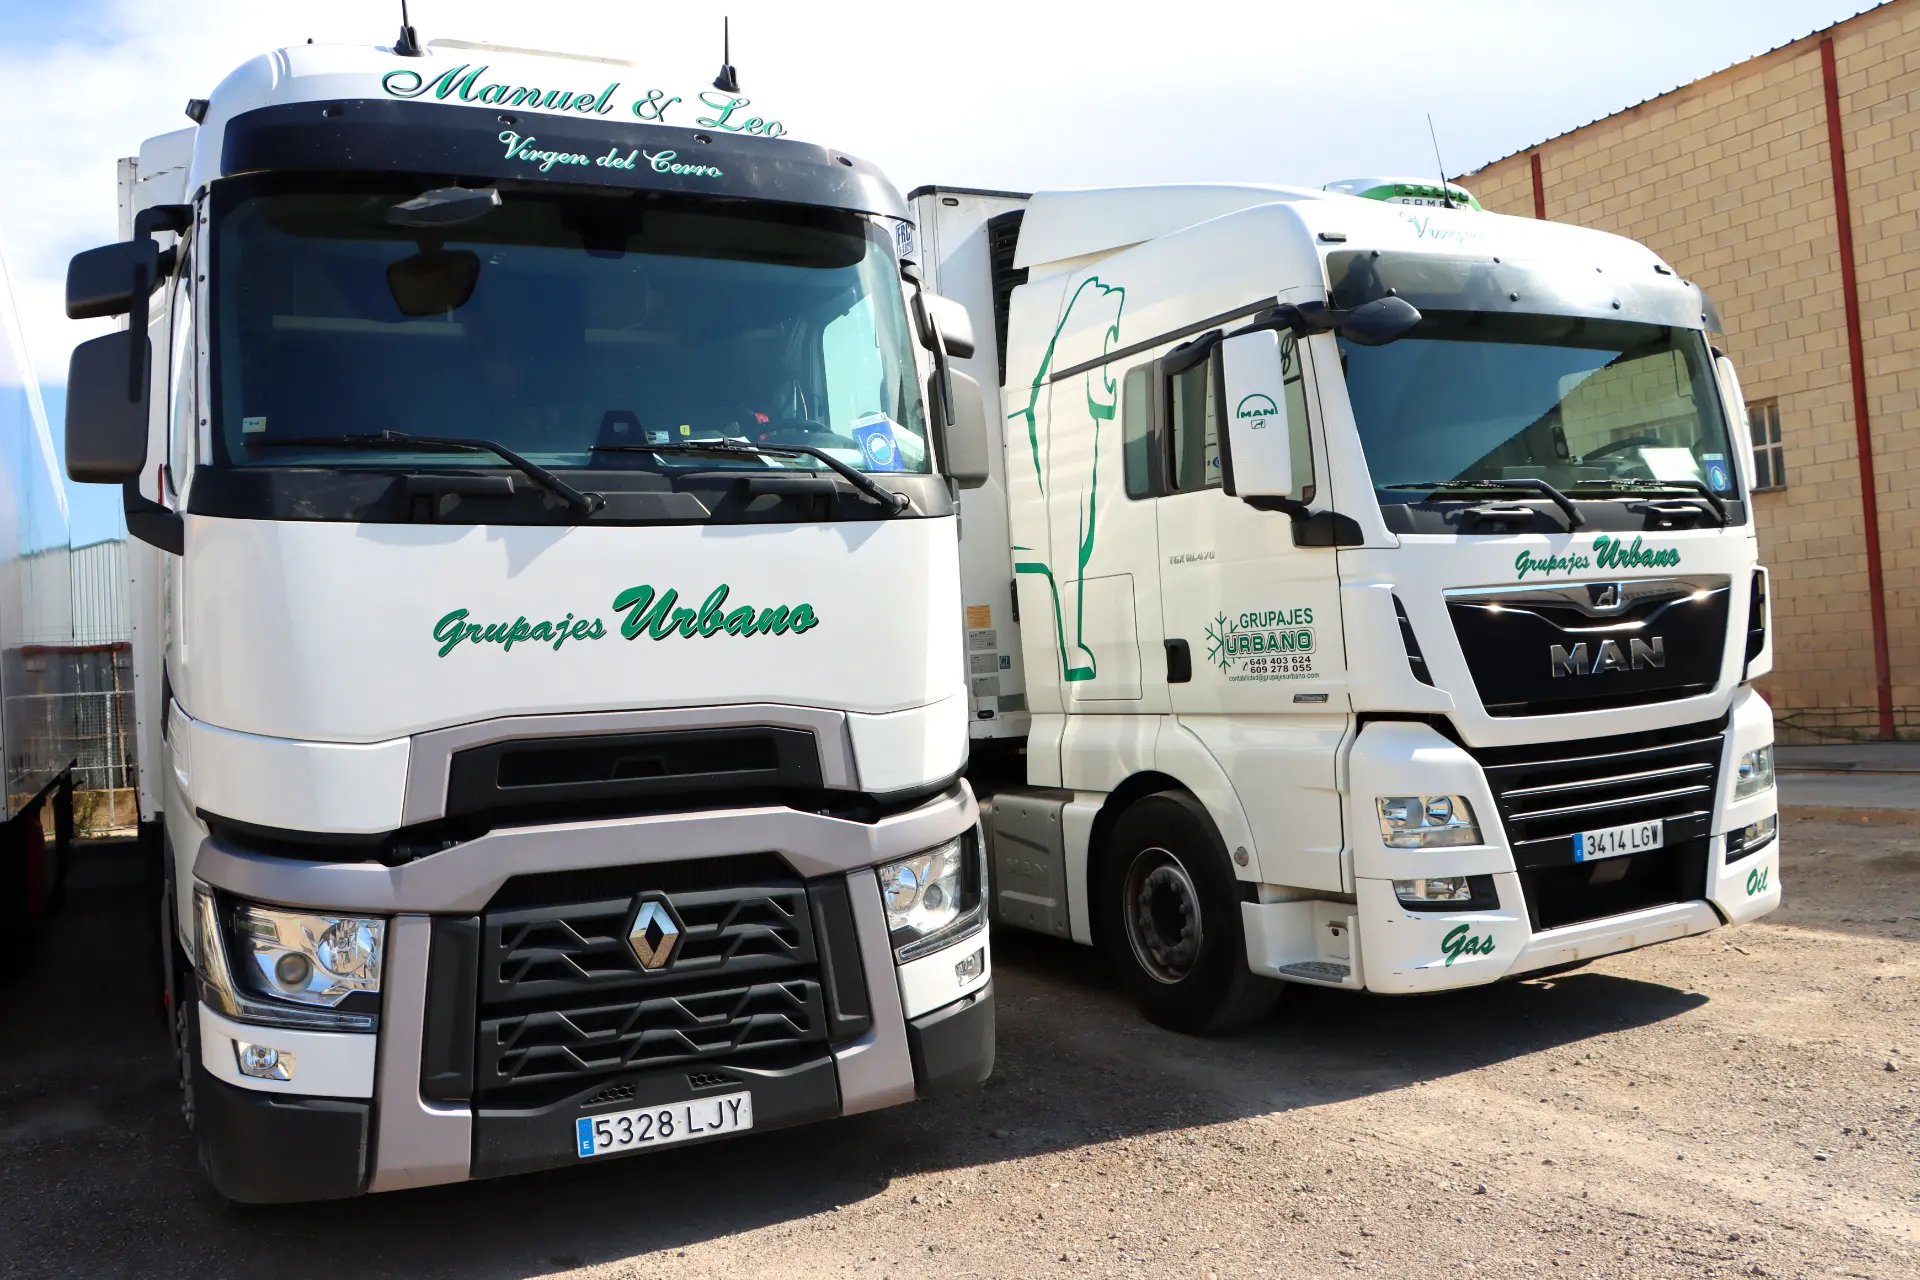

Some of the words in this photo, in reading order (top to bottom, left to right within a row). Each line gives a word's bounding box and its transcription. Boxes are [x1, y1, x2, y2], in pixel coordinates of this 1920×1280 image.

[381, 62, 622, 116] Manuel
[631, 88, 683, 122] &
[695, 90, 788, 138] Leo
[498, 129, 590, 173] Virgen
[596, 147, 637, 170] del
[642, 149, 724, 179] Cerro
[1401, 197, 1469, 211] COMPCT
[1240, 408, 1275, 419] MAN
[1514, 549, 1590, 580] Grupajes
[1592, 534, 1681, 570] Urbano
[432, 608, 608, 658] Grupajes
[612, 583, 820, 641] Urbano
[1239, 607, 1314, 629] GRUPAJES
[1225, 629, 1314, 656] URBANO
[1550, 636, 1666, 678] MAN
[1249, 657, 1268, 666] 649
[1270, 656, 1289, 665] 403
[1291, 655, 1312, 664] 624
[1250, 665, 1269, 674] 609
[1270, 664, 1290, 673] 278
[1292, 663, 1313, 672] 055
[1587, 830, 1627, 855] 3414
[1631, 824, 1659, 849] LGW
[1746, 866, 1768, 896] Oil
[1441, 923, 1496, 967] Gas
[583, 1140, 590, 1150] E
[595, 1110, 675, 1148] 5328
[686, 1097, 742, 1134] LJY
